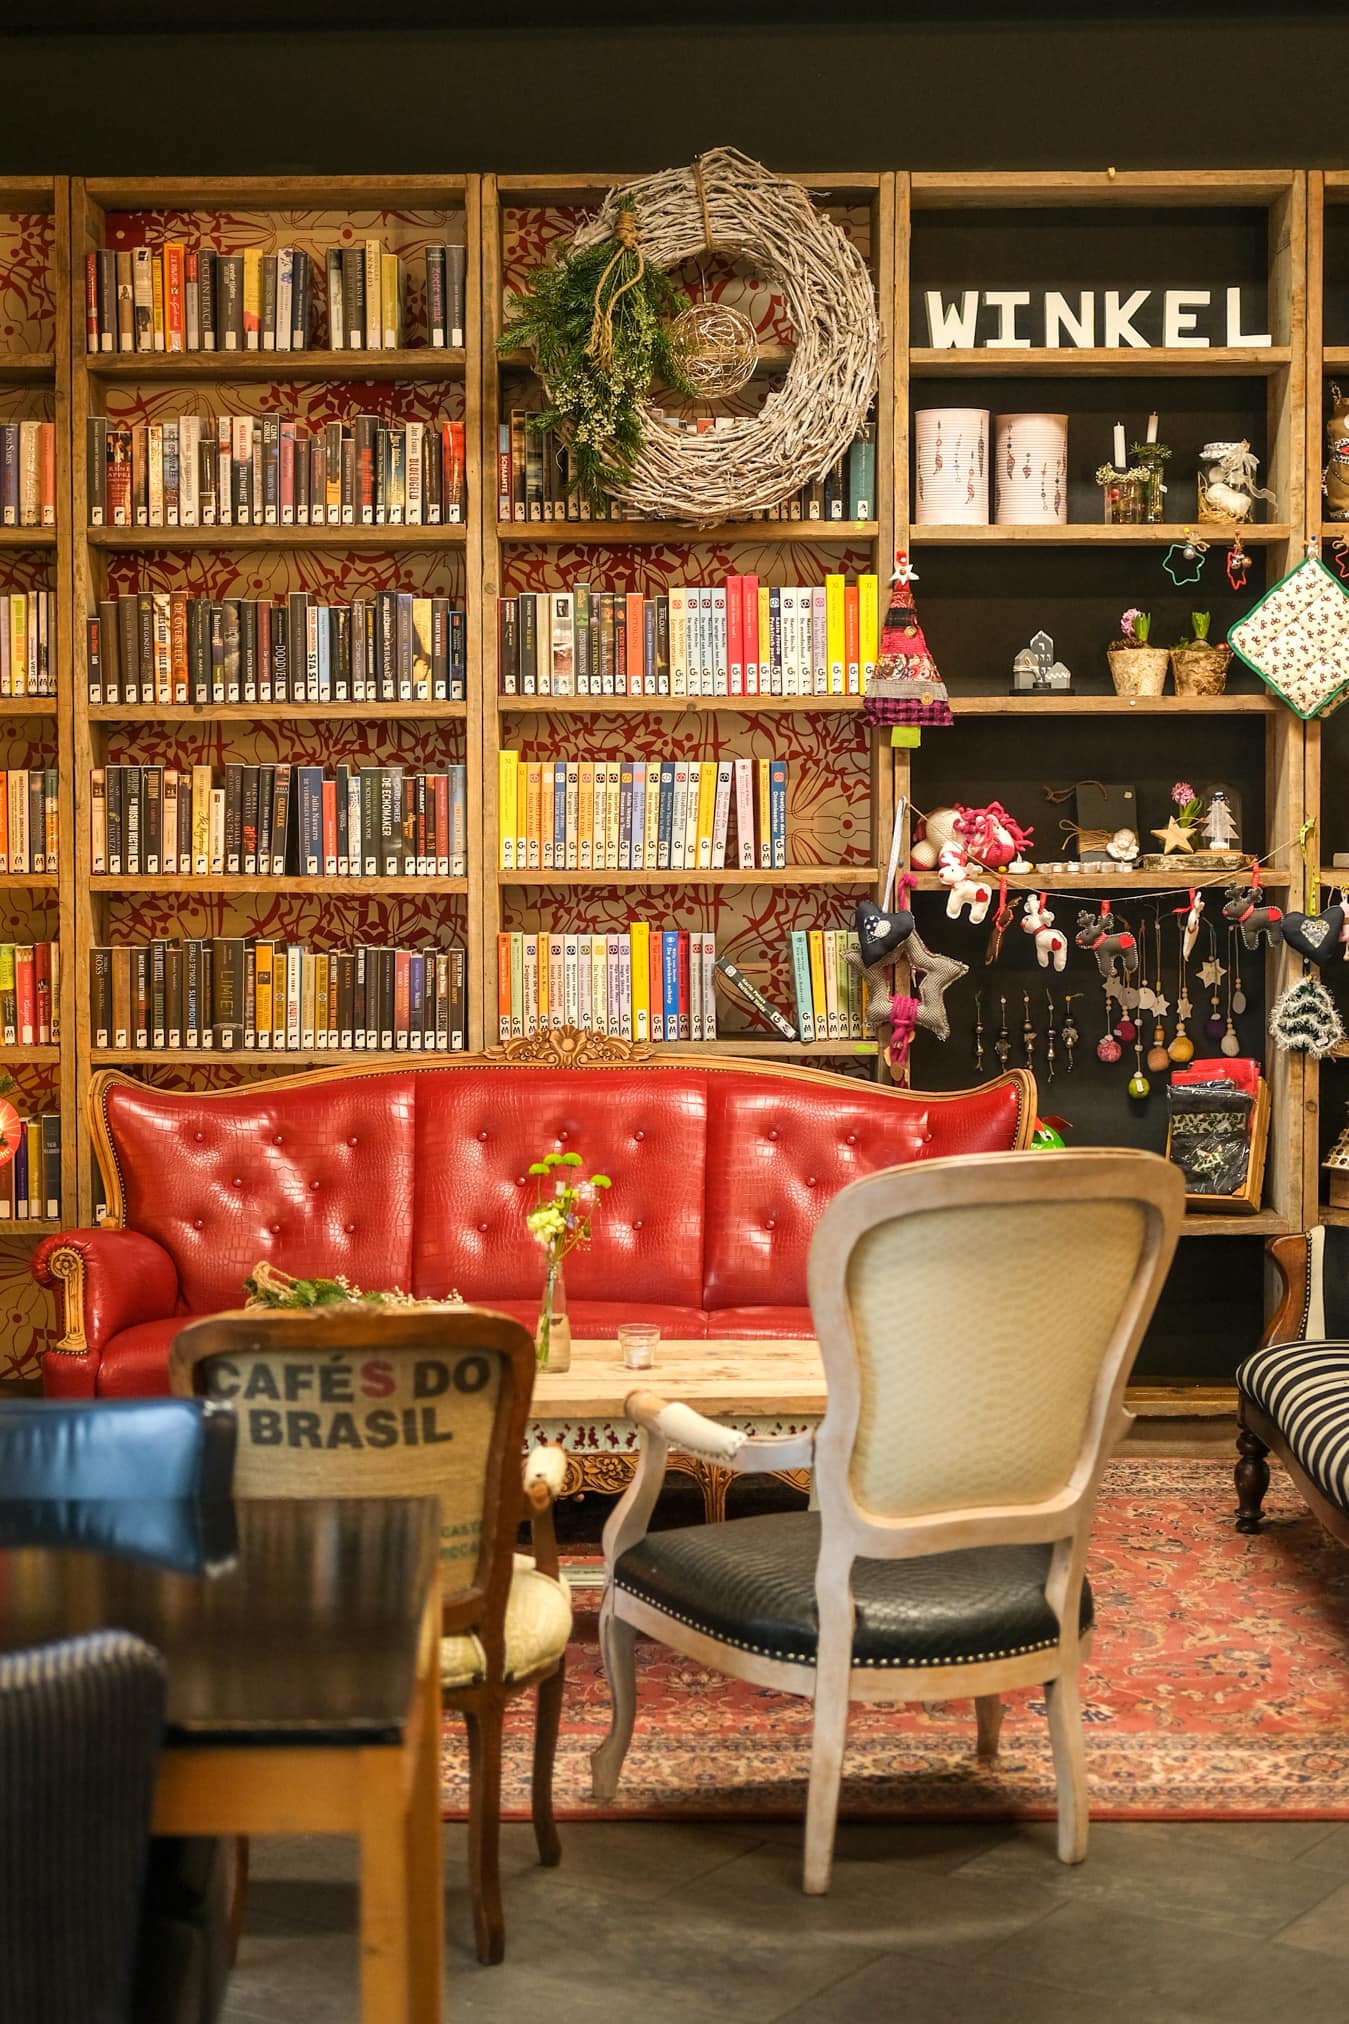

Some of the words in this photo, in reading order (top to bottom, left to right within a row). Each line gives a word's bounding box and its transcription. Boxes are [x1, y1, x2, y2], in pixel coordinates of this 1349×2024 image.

[925, 287, 1272, 348] WINKEL
[240, 467, 248, 480] STAAT
[409, 458, 419, 500] BLOEDGELD
[174, 618, 184, 664] OVERSTEEK
[676, 668, 684, 678] G
[718, 668, 726, 676] G
[760, 666, 769, 674] G
[802, 667, 810, 675] G
[148, 772, 159, 799] LUDLUM
[382, 778, 392, 788] DE
[312, 795, 320, 812] Julia
[382, 790, 392, 836] ECHOMAKER
[128, 805, 138, 831] MOSKOU
[312, 813, 320, 841] Navarro
[128, 832, 138, 855] VECTOR
[517, 841, 525, 849] G
[556, 844, 563, 852] G
[154, 946, 164, 960] CRAIG
[96, 954, 104, 975] ROSS
[154, 961, 164, 982] RUSSELL
[220, 970, 235, 1018] LIMIET
[802, 1012, 809, 1020] G
[208, 1356, 396, 1403] CAFÉS
[413, 1356, 491, 1400] DO
[248, 1407, 453, 1449] BRASIL
